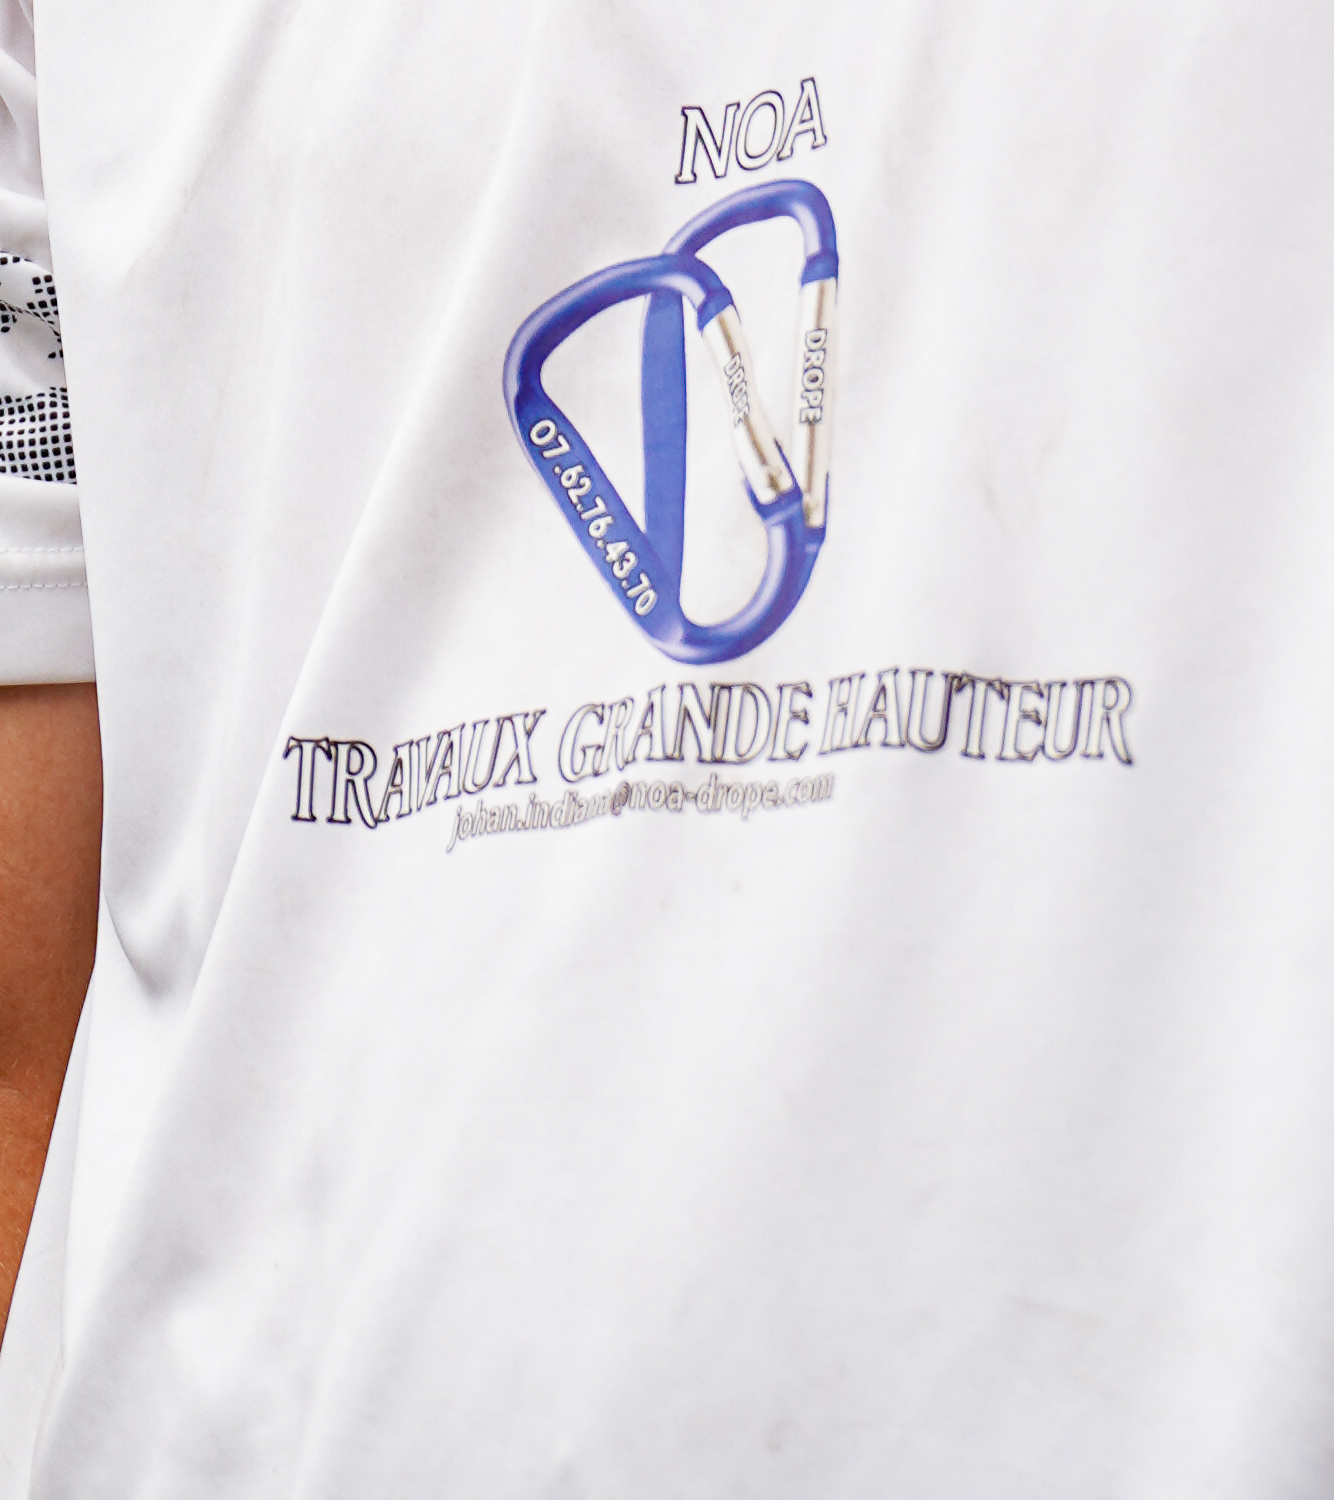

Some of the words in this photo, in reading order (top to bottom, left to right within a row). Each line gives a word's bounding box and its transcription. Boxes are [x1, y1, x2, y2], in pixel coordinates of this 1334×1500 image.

[674, 76, 827, 184] NOA
[799, 328, 828, 424] DROPE
[283, 706, 547, 829] TRAVAUX
[557, 681, 813, 784] GRANDE
[818, 666, 1134, 766] HAUTEUR
